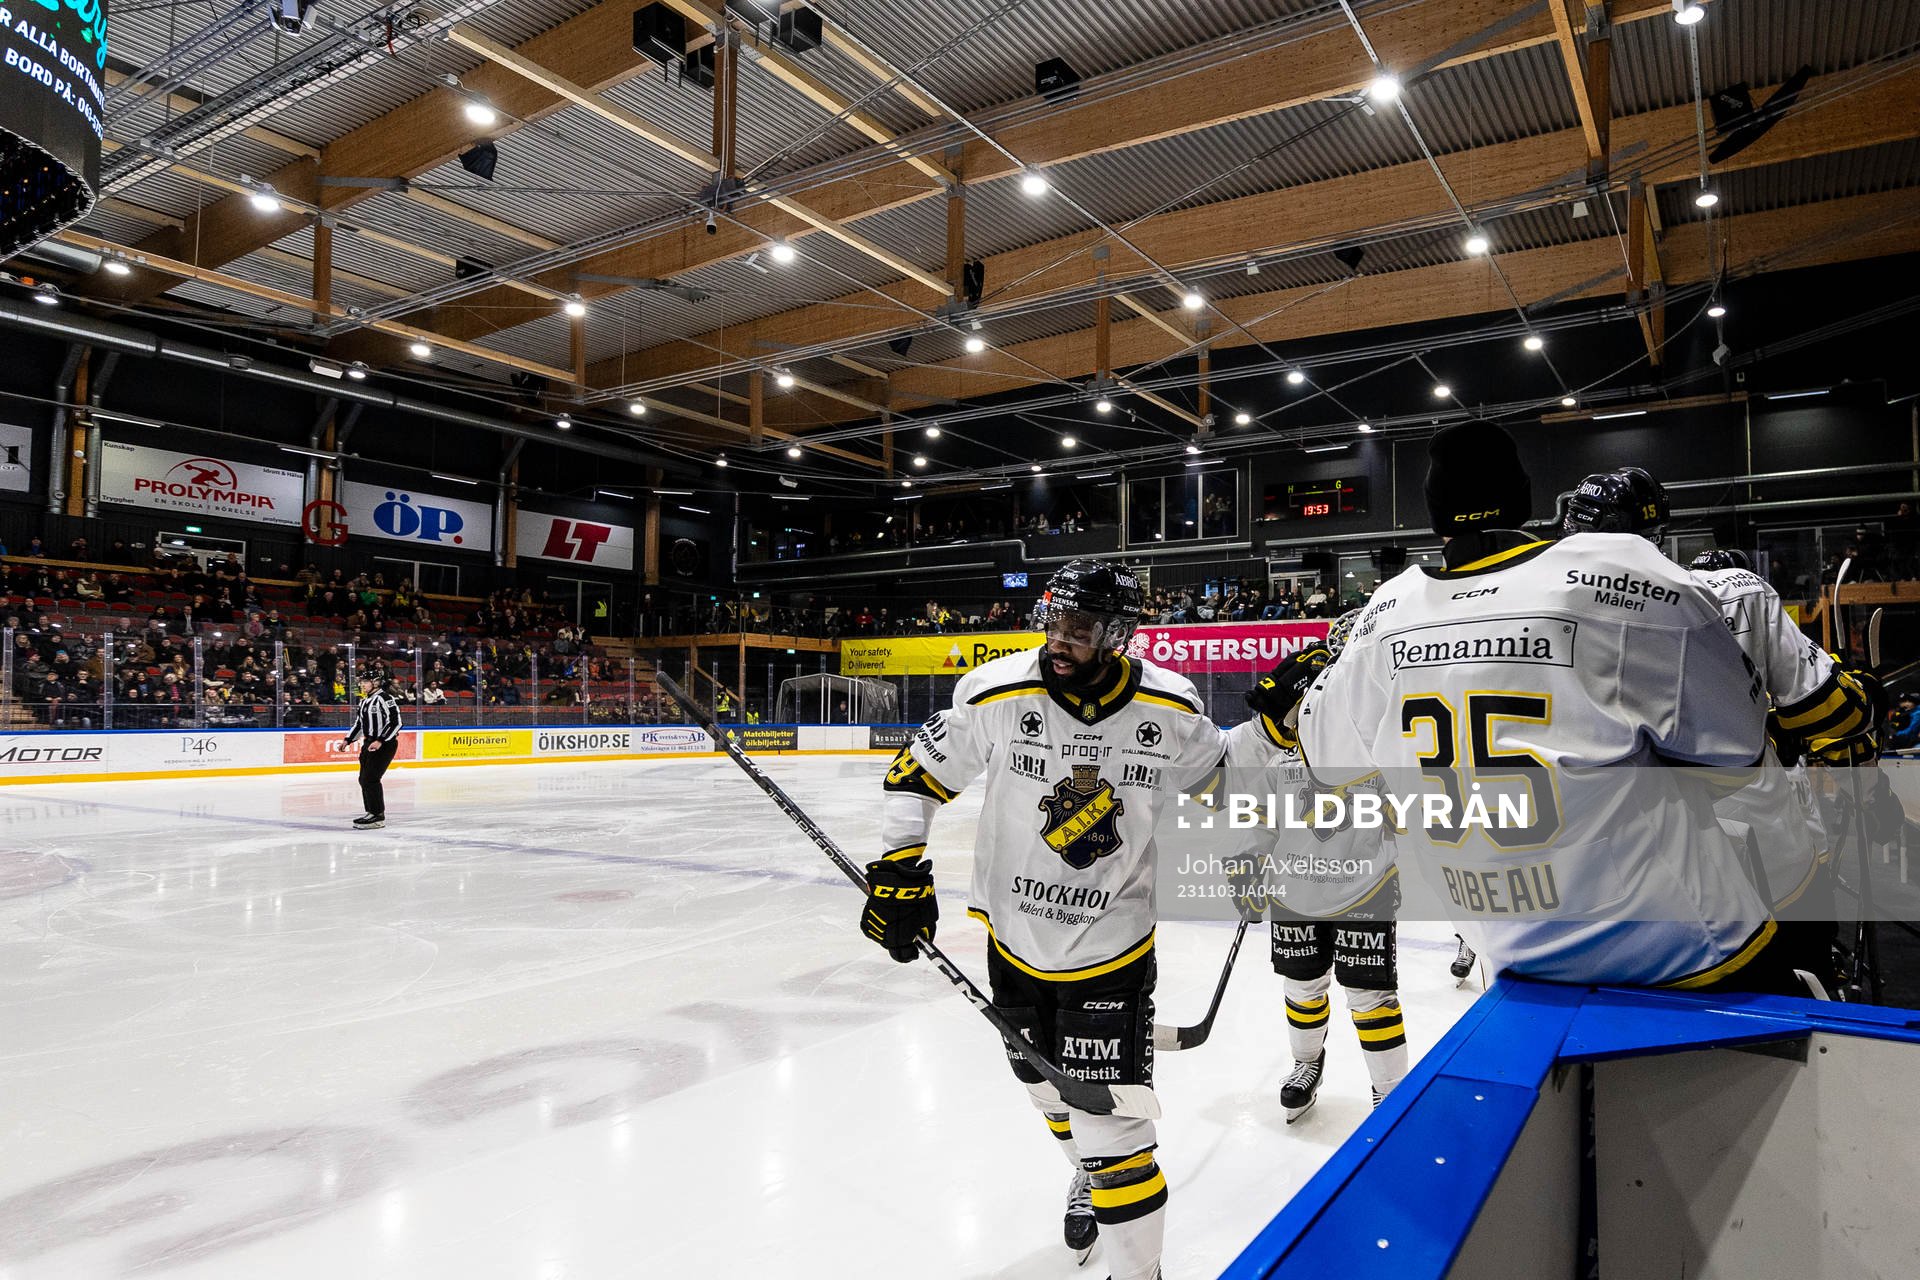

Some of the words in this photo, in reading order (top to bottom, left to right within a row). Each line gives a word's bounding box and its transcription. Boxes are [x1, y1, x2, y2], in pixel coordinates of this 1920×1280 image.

[14, 20, 57, 57] ALLA
[5, 47, 53, 86] BORD
[55, 78, 76, 106] PÅ:
[134, 478, 274, 510] PROLYMPIA
[1288, 485, 1295, 494] H
[102, 494, 135, 505] Trygghet
[154, 497, 168, 505] EN
[172, 500, 203, 509] SKOLA
[215, 505, 256, 516] RÖRELSE
[1304, 504, 1329, 516] 19:53
[1454, 508, 1500, 522] CCM
[1577, 513, 1594, 522] CCM
[1642, 504, 1657, 519] 15
[302, 500, 349, 546] G
[542, 518, 611, 563] LT
[1051, 587, 1076, 598] CCM
[1452, 586, 1500, 600] CCM
[1566, 569, 1681, 606] Sundsten
[1052, 597, 1079, 608] SVENSKA
[1594, 589, 1647, 612] Måleri
[850, 648, 866, 657] Your
[867, 647, 892, 657] safety.
[1389, 627, 1553, 670] Bemannia
[848, 660, 886, 670] Delivered.
[452, 735, 507, 747] Miljönären
[538, 733, 630, 750] ÖIKSHOP.SE
[642, 732, 658, 742] PK
[689, 732, 705, 742] AB
[743, 731, 794, 739] Matchbiljetter
[182, 736, 217, 755] P46
[0, 747, 103, 762] MOTOR
[729, 743, 768, 777] CCM
[1026, 772, 1050, 784] RENTAL
[1402, 689, 1565, 853] 35
[768, 787, 835, 860] JETSPEED
[873, 885, 935, 900] CCM
[1441, 863, 1560, 914] BIBEAU
[1018, 901, 1044, 916] Måleri
[1045, 907, 1054, 919] &
[1272, 923, 1317, 943] ATM
[1335, 929, 1386, 950] ATM
[1273, 943, 1318, 958] Logistik
[1335, 950, 1385, 966] Logistik
[1082, 1001, 1126, 1010] CCM
[1062, 1036, 1121, 1060] ATM
[1061, 1063, 1121, 1082] Logistik
